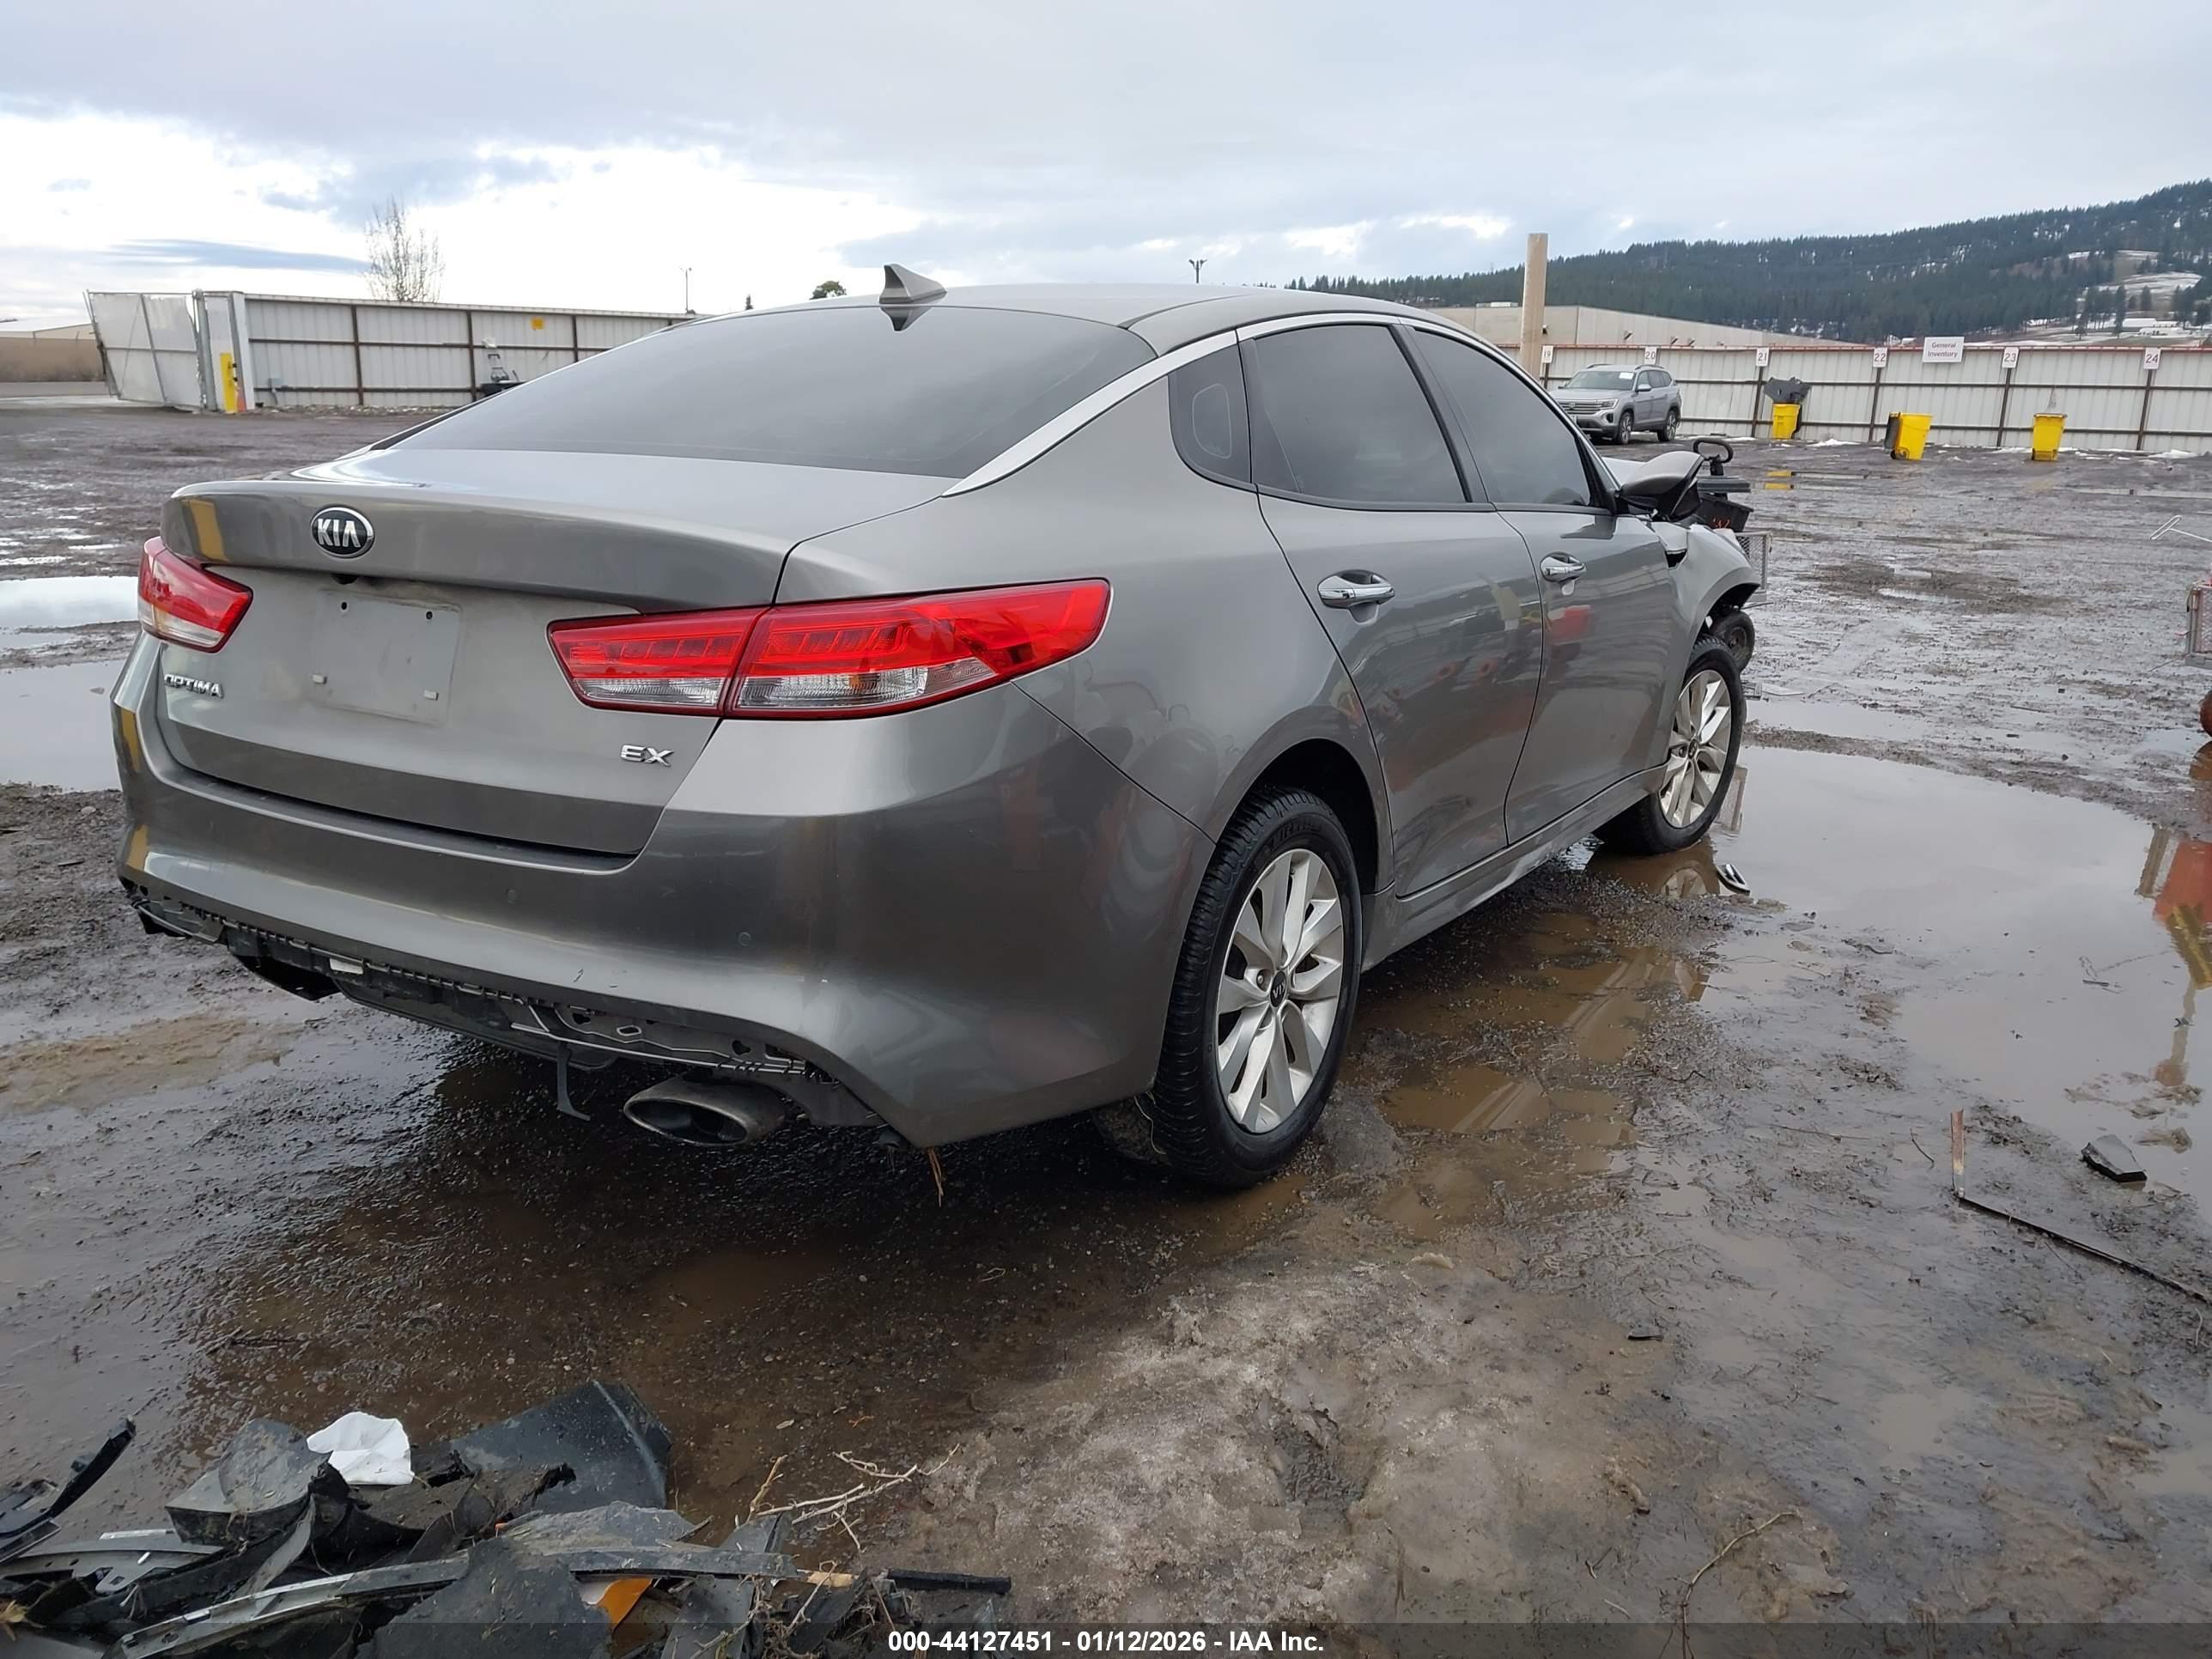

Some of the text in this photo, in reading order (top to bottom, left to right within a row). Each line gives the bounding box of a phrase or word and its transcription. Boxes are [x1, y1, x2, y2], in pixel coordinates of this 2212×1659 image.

[1543, 349, 1552, 358] 19
[1644, 350, 1656, 360] 20
[1758, 352, 1767, 362] 21
[1874, 352, 1887, 362] 22
[2003, 353, 2016, 362] 23
[2145, 354, 2159, 363] 24
[317, 518, 362, 548] KIA
[163, 673, 224, 699] OPTIMA
[620, 744, 675, 767] EX
